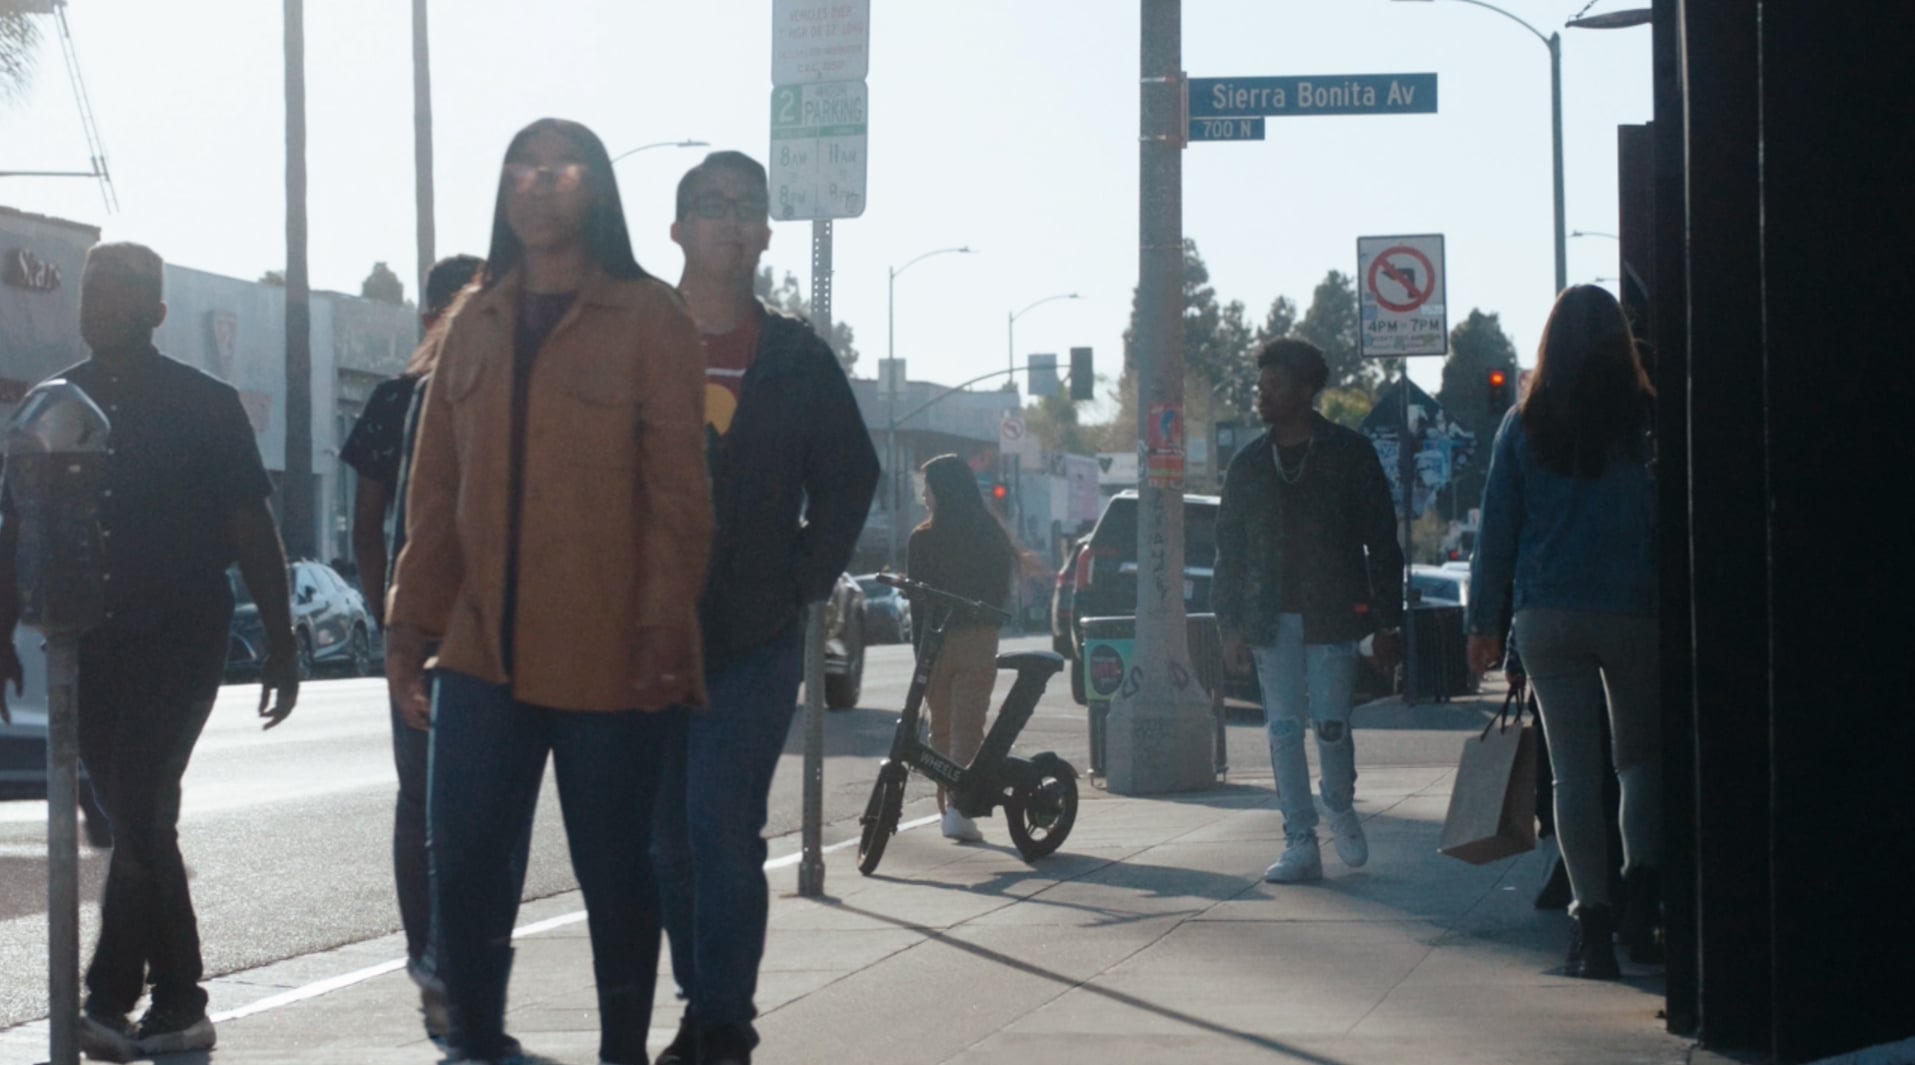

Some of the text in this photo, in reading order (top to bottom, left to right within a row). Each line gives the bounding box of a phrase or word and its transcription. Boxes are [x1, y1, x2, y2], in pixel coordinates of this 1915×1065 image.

[779, 89, 796, 123] 2
[1212, 80, 1416, 109] Sierra Bonita Av
[804, 96, 863, 125] PARKING
[1203, 119, 1252, 138] 700 N
[1367, 319, 1398, 333] 4PM
[1410, 318, 1439, 332] 7PM
[920, 751, 961, 783] WHEELS
